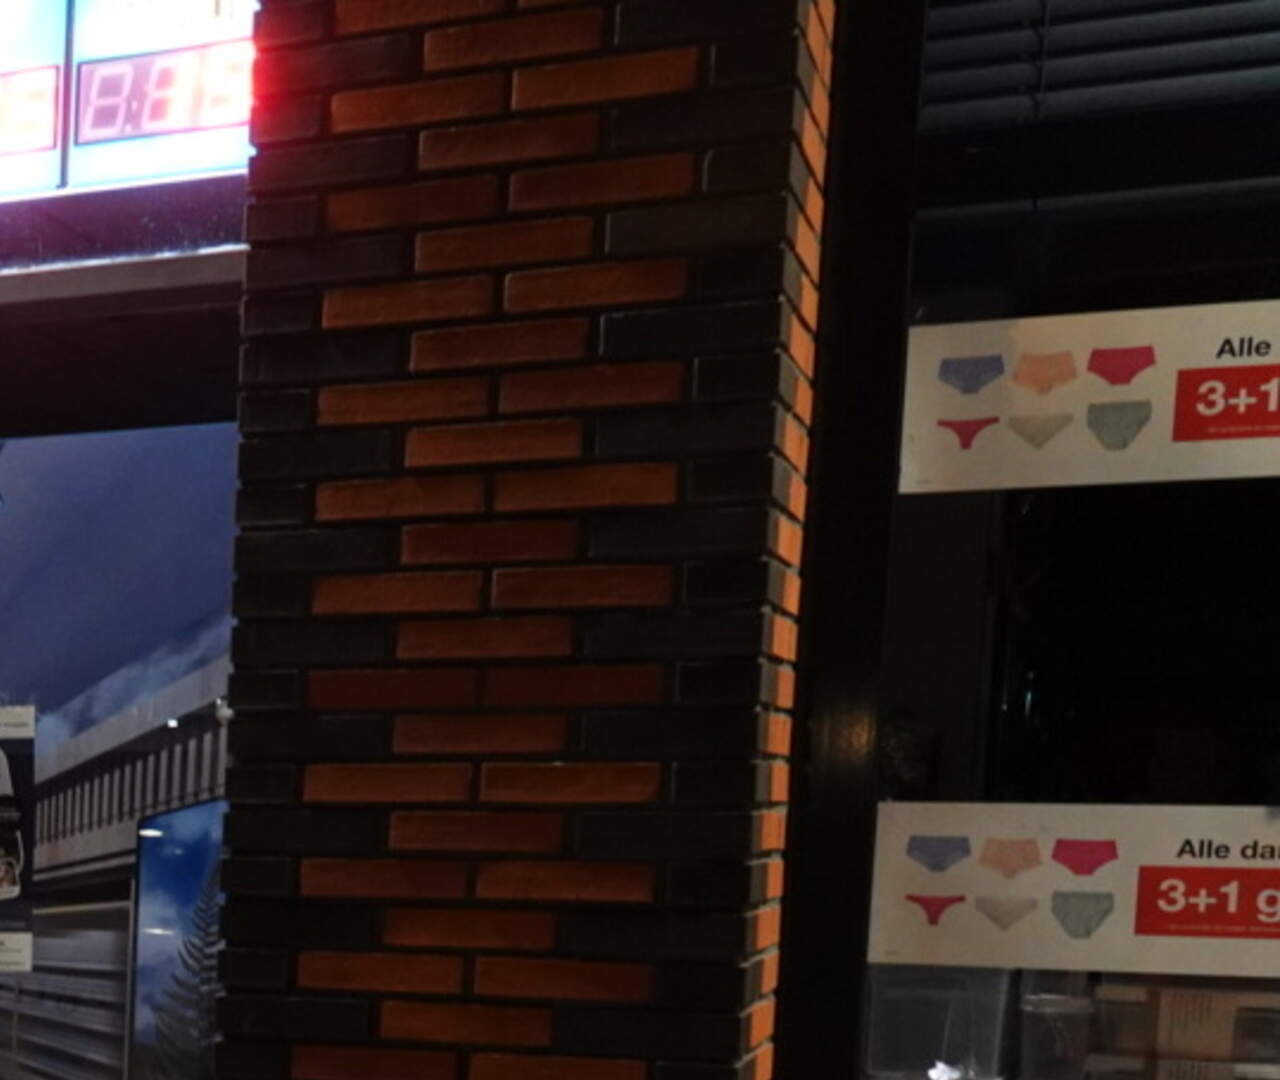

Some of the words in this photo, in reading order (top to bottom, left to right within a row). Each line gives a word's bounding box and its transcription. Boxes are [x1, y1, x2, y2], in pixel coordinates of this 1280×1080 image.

[1216, 336, 1272, 359] Alle
[1196, 378, 1280, 416] 3+1
[1177, 839, 1231, 859] Alle
[1240, 839, 1280, 860] da
[1157, 878, 1239, 915] 3+1
